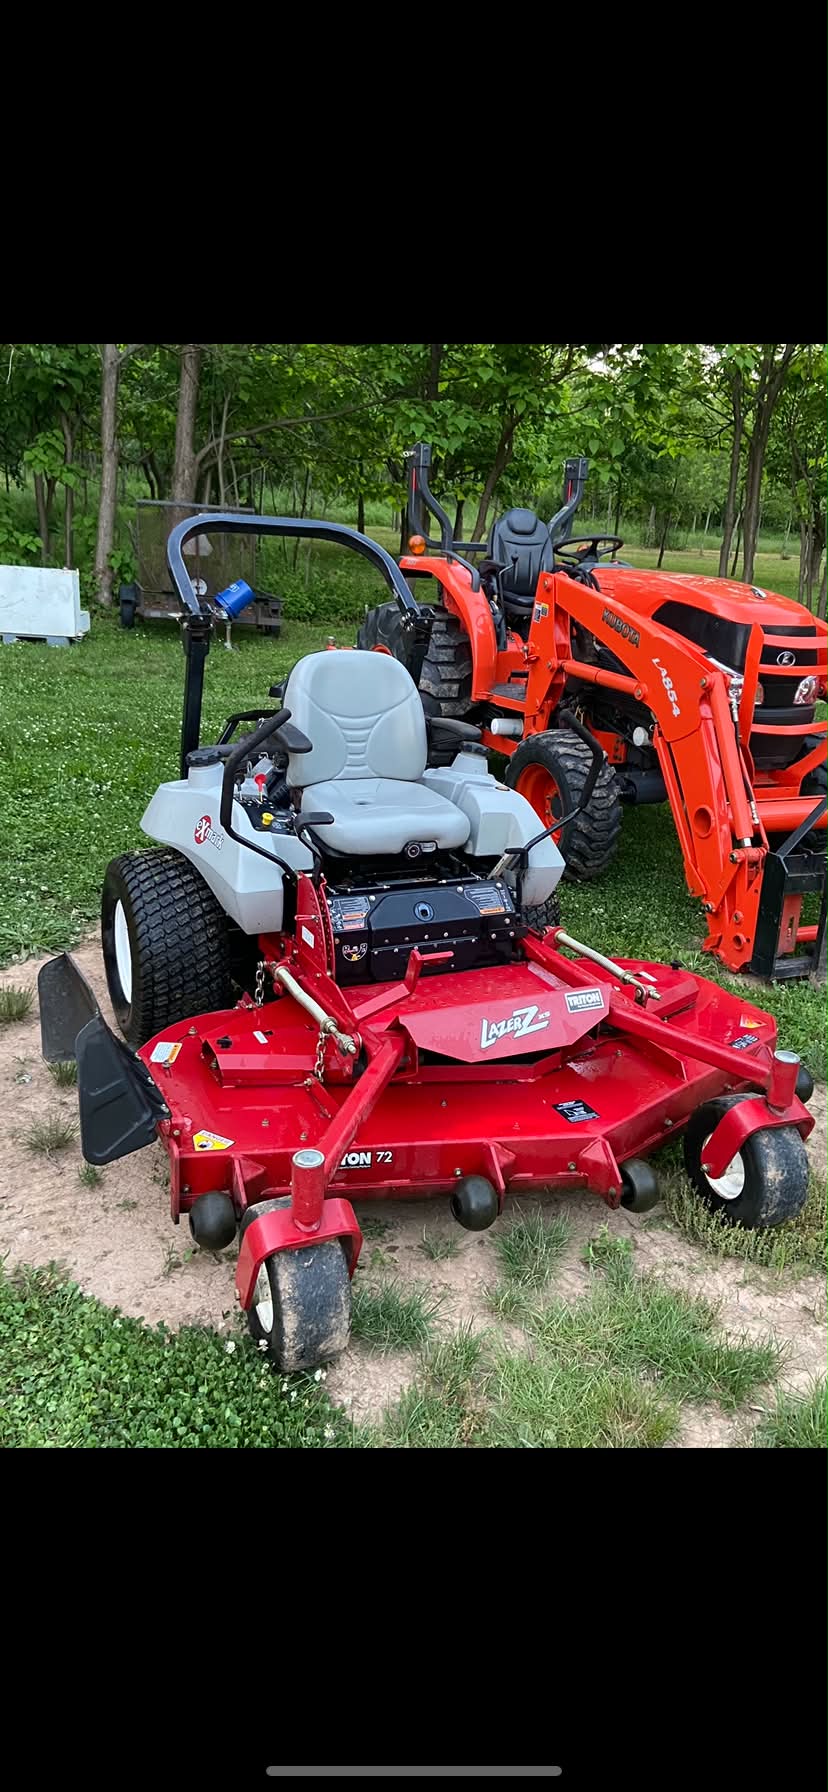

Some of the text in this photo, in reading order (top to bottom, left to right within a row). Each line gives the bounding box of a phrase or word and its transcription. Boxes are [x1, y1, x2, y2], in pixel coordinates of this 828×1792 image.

[602, 608, 640, 647] KUBOTA
[651, 658, 681, 717] LA854
[567, 992, 600, 1007] TRITON
[340, 1151, 393, 1166] TON 72
